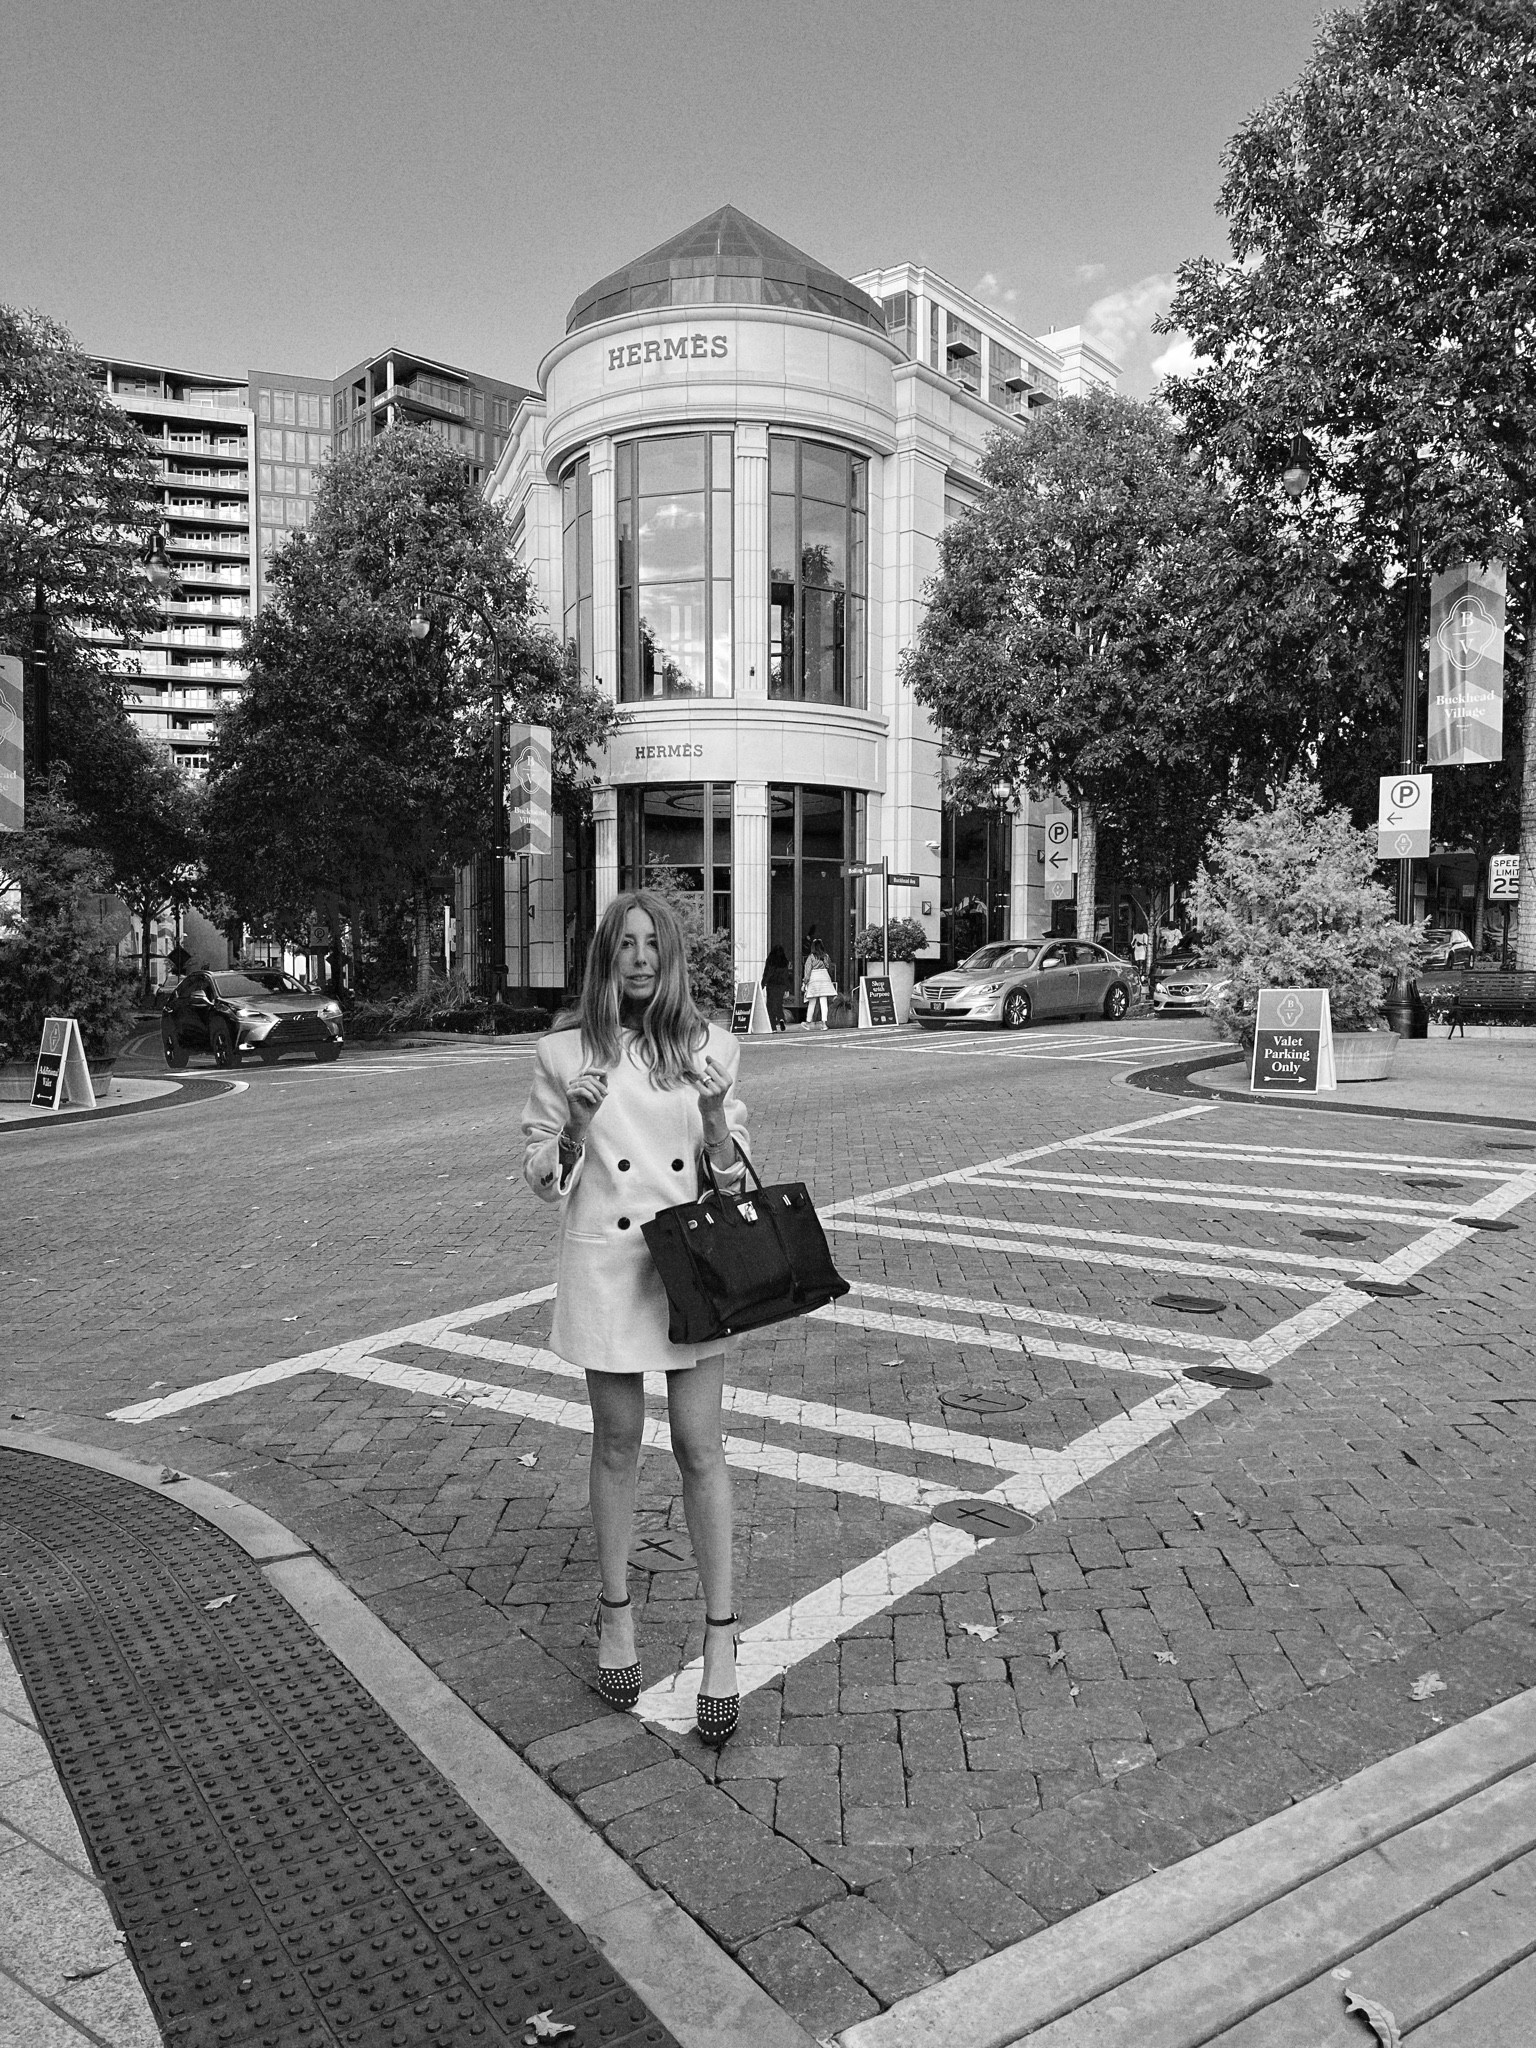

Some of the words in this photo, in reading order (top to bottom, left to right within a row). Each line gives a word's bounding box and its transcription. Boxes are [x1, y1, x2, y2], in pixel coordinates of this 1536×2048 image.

[608, 333, 728, 371] HERMÈS
[1461, 611, 1474, 628] B
[1459, 638, 1474, 655] V
[1436, 689, 1495, 706] Buckhead
[1444, 707, 1486, 719] Village
[635, 742, 703, 760] HERMÈS
[1399, 785, 1414, 804] P
[1054, 826, 1064, 841] P
[1493, 877, 1520, 894] 25
[1288, 1000, 1294, 1008] B
[1287, 1012, 1294, 1020] V
[1273, 1035, 1303, 1047] Valet
[1264, 1048, 1310, 1062] Parking
[1271, 1061, 1301, 1074] Only
